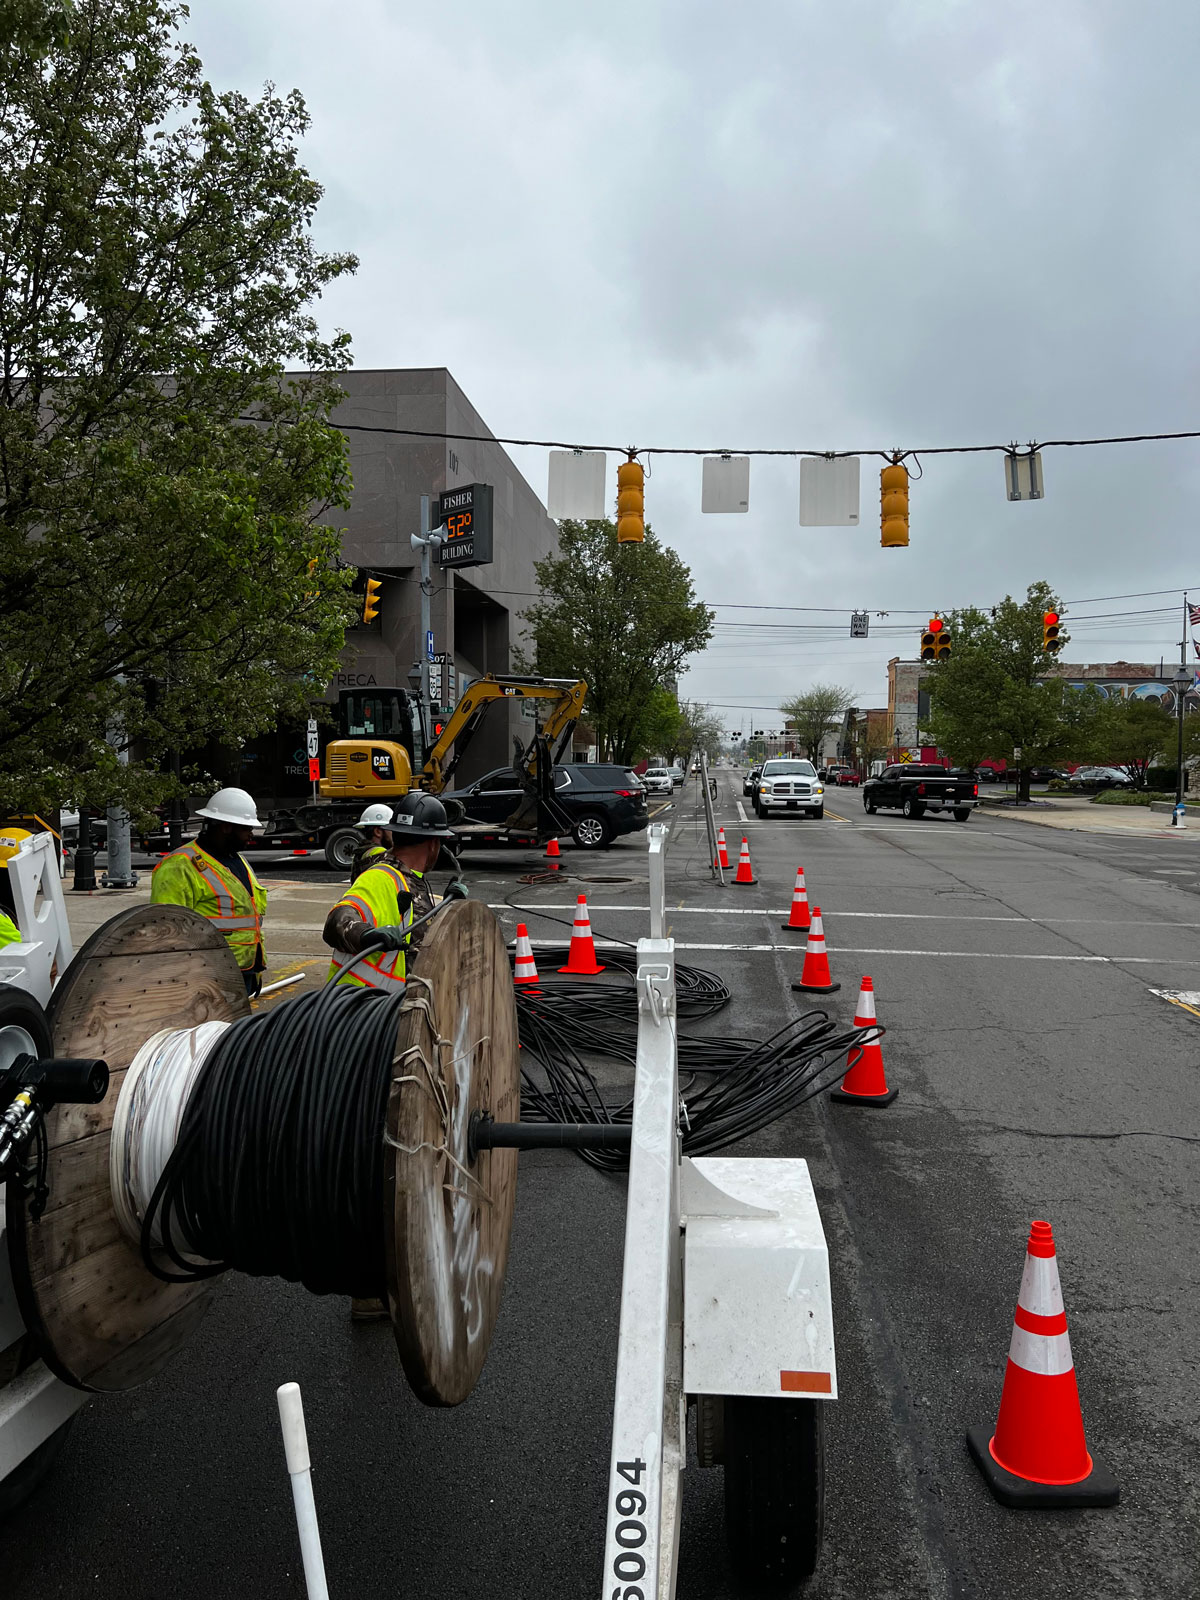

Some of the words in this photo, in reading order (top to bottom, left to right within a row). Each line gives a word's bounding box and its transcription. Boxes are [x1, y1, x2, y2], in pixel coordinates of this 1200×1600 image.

[444, 491, 472, 509] FISHER
[442, 543, 473, 560] BUILDING
[331, 673, 377, 687] TRECA
[504, 687, 516, 696] CAT
[308, 737, 318, 752] 47
[373, 755, 390, 767] CAT
[284, 765, 309, 775] TREC
